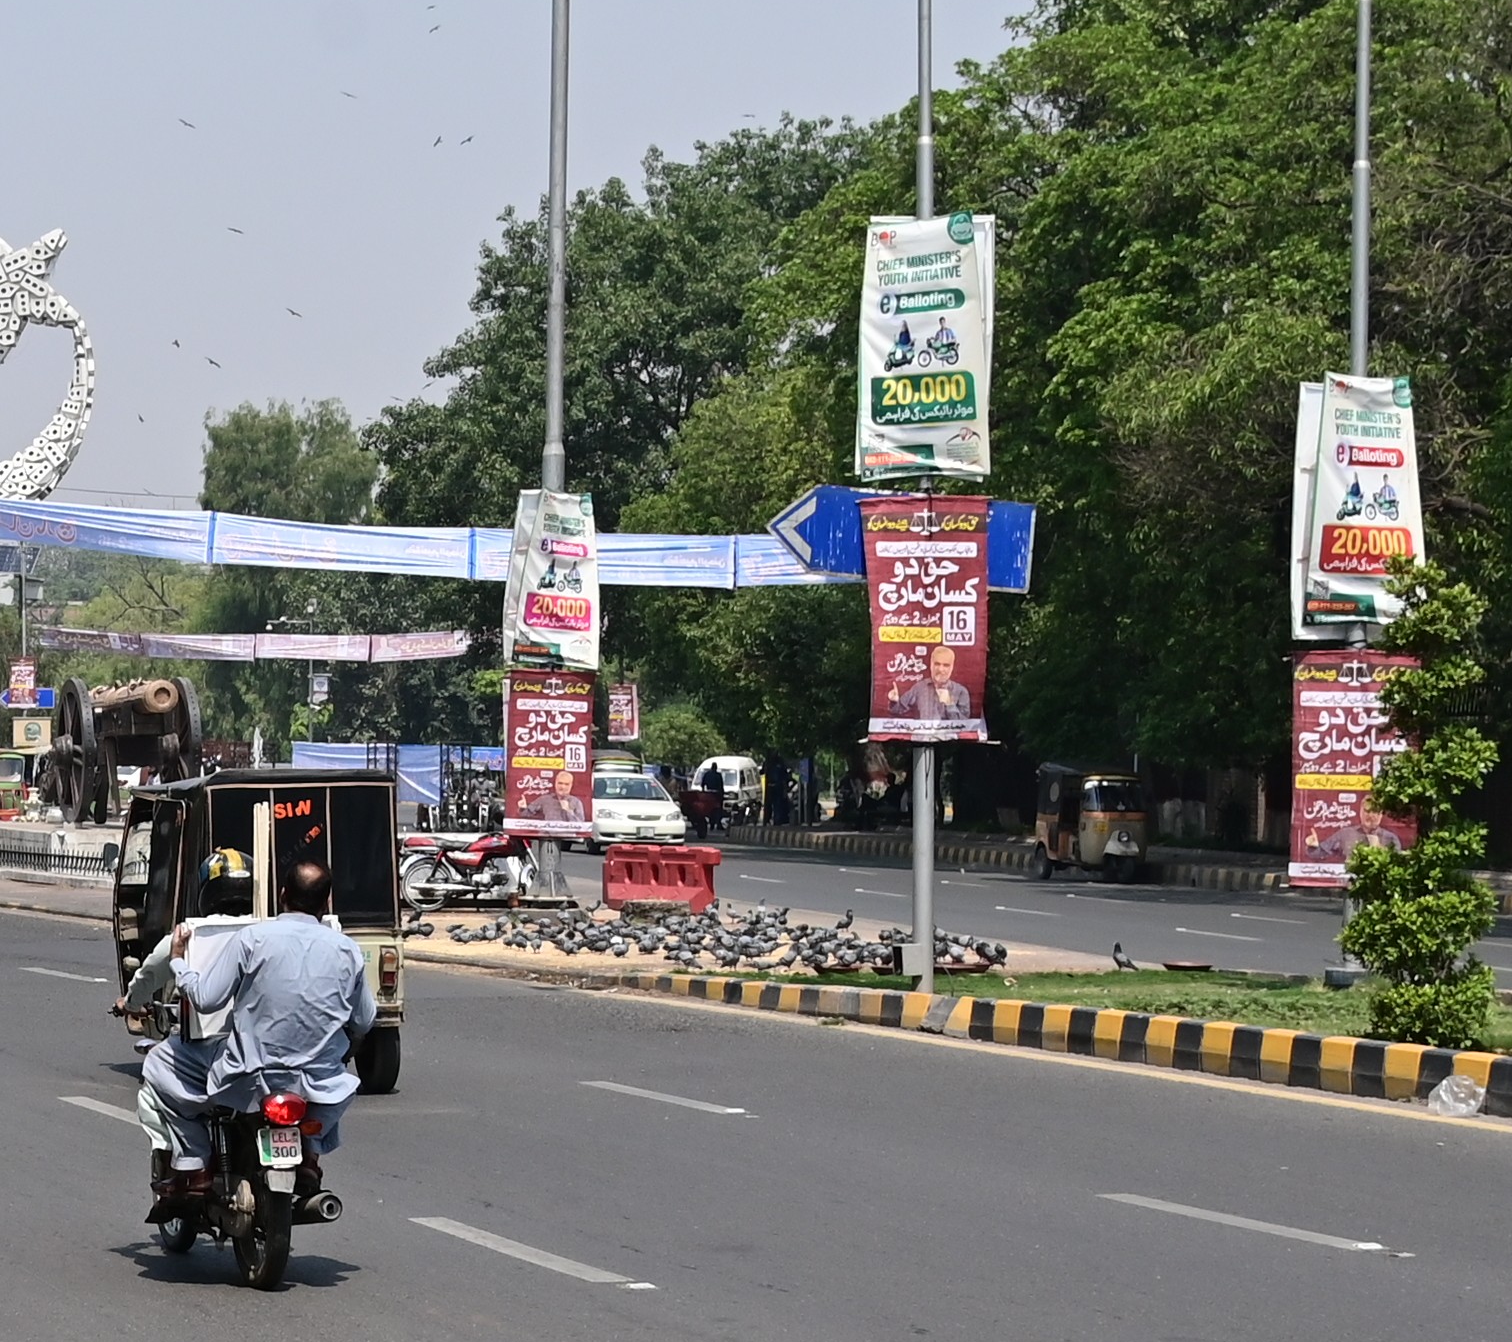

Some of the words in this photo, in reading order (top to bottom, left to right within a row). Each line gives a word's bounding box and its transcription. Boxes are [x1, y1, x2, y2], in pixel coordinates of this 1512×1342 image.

[877, 257, 905, 272] CHIEF
[906, 250, 962, 269] MINISTER'S
[877, 271, 908, 287] YOUTH
[911, 265, 962, 283] INITIATIVE
[899, 291, 955, 309] Balloting
[881, 373, 966, 406] 20,000
[1335, 408, 1354, 420] CHIEF
[1356, 410, 1401, 424] MINISTER'S
[1335, 423, 1358, 435] YOUTH
[1360, 425, 1401, 438] INITIATIVE
[1352, 449, 1397, 465] Balloting
[1331, 528, 1406, 556] 20,000
[890, 557, 919, 583] دو
[921, 557, 960, 584] حق
[878, 579, 923, 611] مارچ
[922, 577, 980, 608] کسان
[532, 595, 586, 618] 20,000
[912, 611, 920, 625] 2
[947, 609, 968, 630] 16
[946, 633, 972, 641] MAY
[525, 710, 546, 728] دو
[547, 710, 576, 729] حق
[1314, 707, 1346, 732] دو
[514, 725, 550, 747] مارچ
[549, 724, 589, 746] کسان
[1298, 728, 1351, 759] مارچ
[569, 747, 582, 761] 16
[1336, 760, 1345, 772] 2
[272, 1131, 291, 1143] LEL
[272, 1146, 298, 1158] 300
